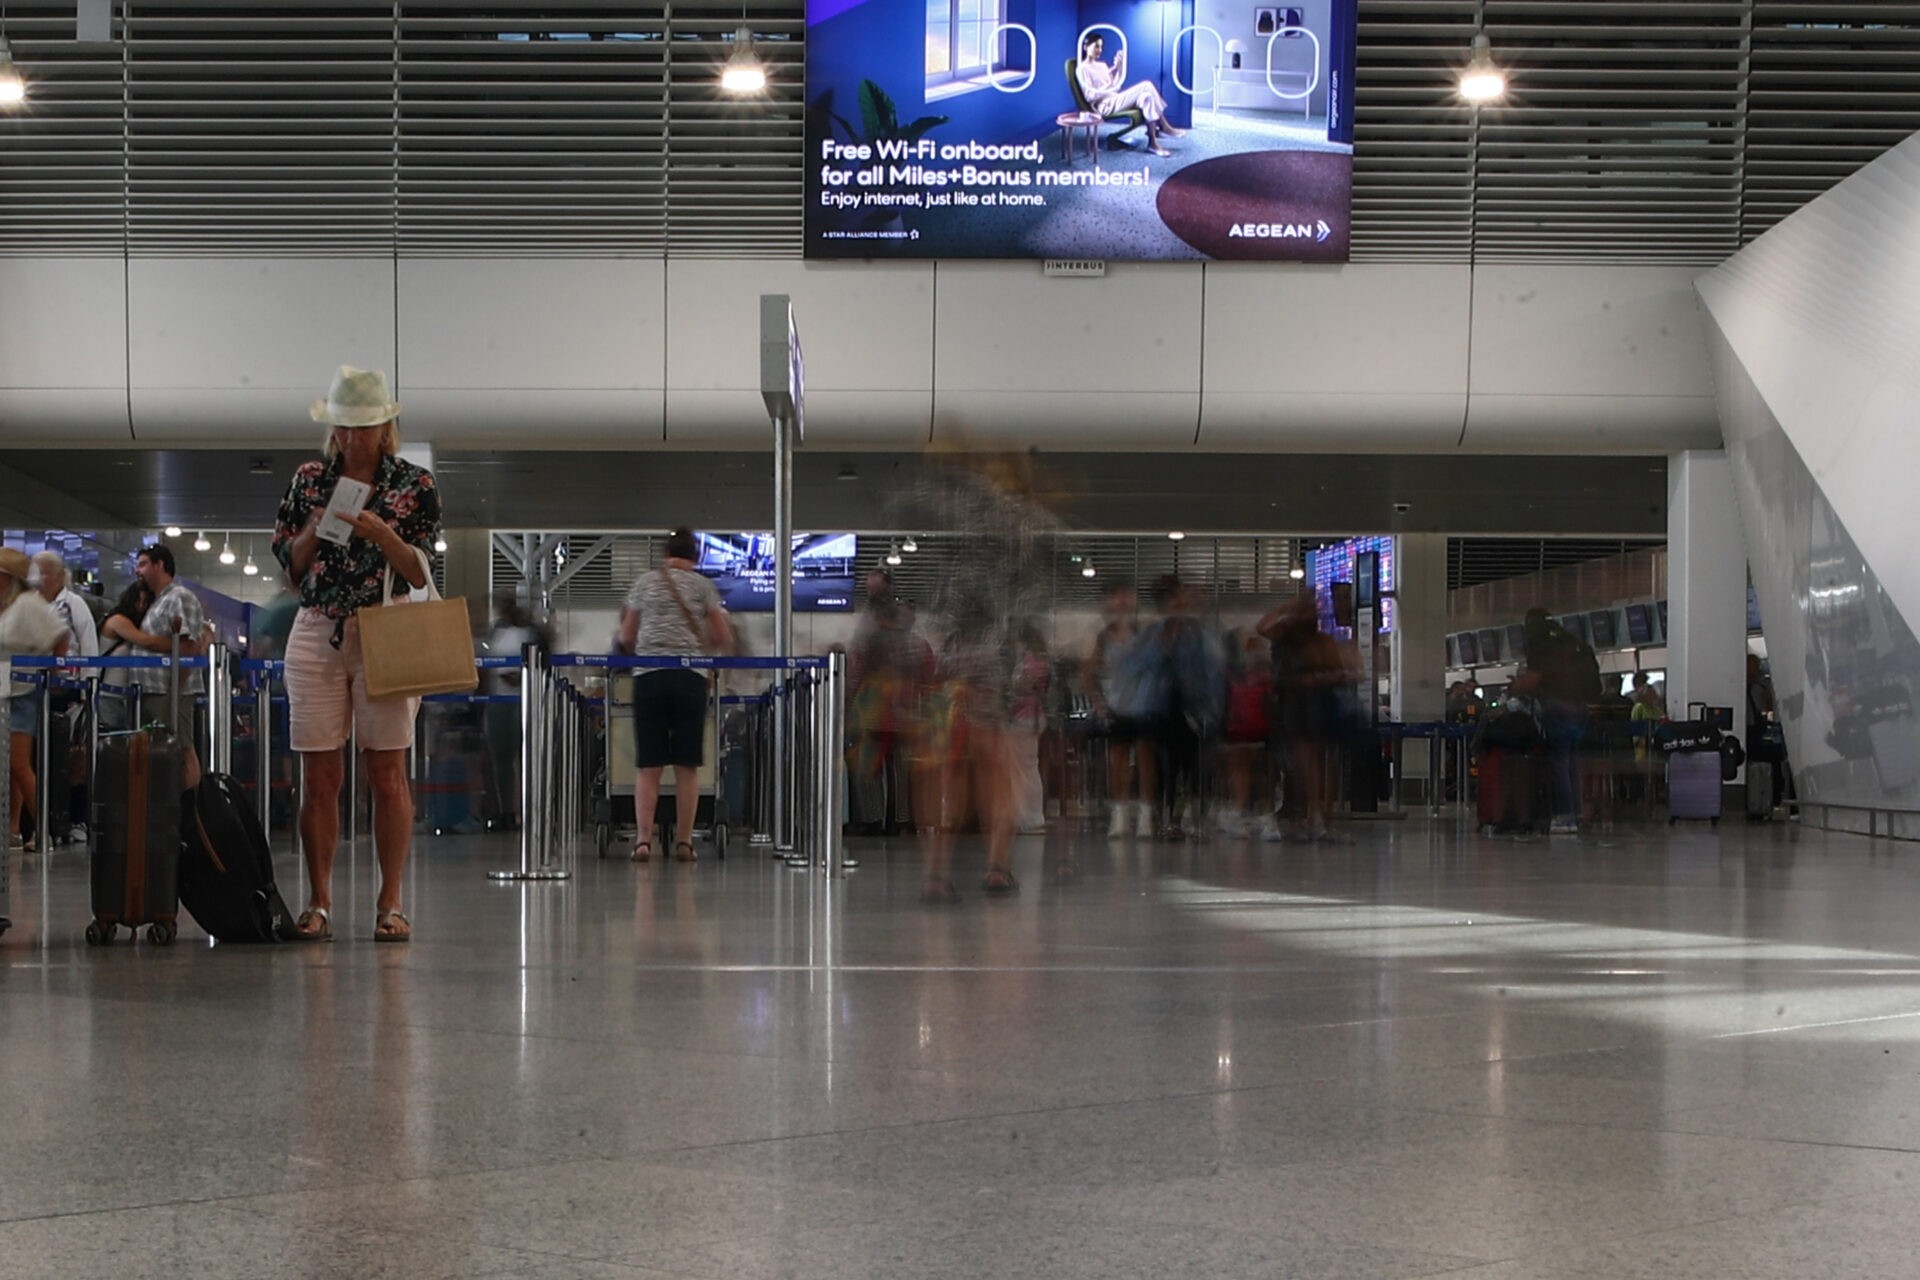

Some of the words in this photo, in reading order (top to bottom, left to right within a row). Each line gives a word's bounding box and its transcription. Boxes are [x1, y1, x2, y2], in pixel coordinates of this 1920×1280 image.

[822, 139, 872, 160] Free
[876, 139, 936, 160] Wi-Fi
[940, 139, 1044, 164] onboard,
[821, 165, 853, 185] for
[856, 165, 884, 185] all
[889, 165, 1031, 186] Miles+Bonus
[1036, 166, 1150, 186] members!
[821, 191, 861, 209] Enjoy
[864, 191, 923, 208] internet,
[924, 192, 951, 209] just
[954, 191, 979, 205] like
[981, 192, 996, 205] at
[999, 192, 1047, 206] home.
[1228, 223, 1312, 238] AEGEAN
[1663, 738, 1695, 750] addas
